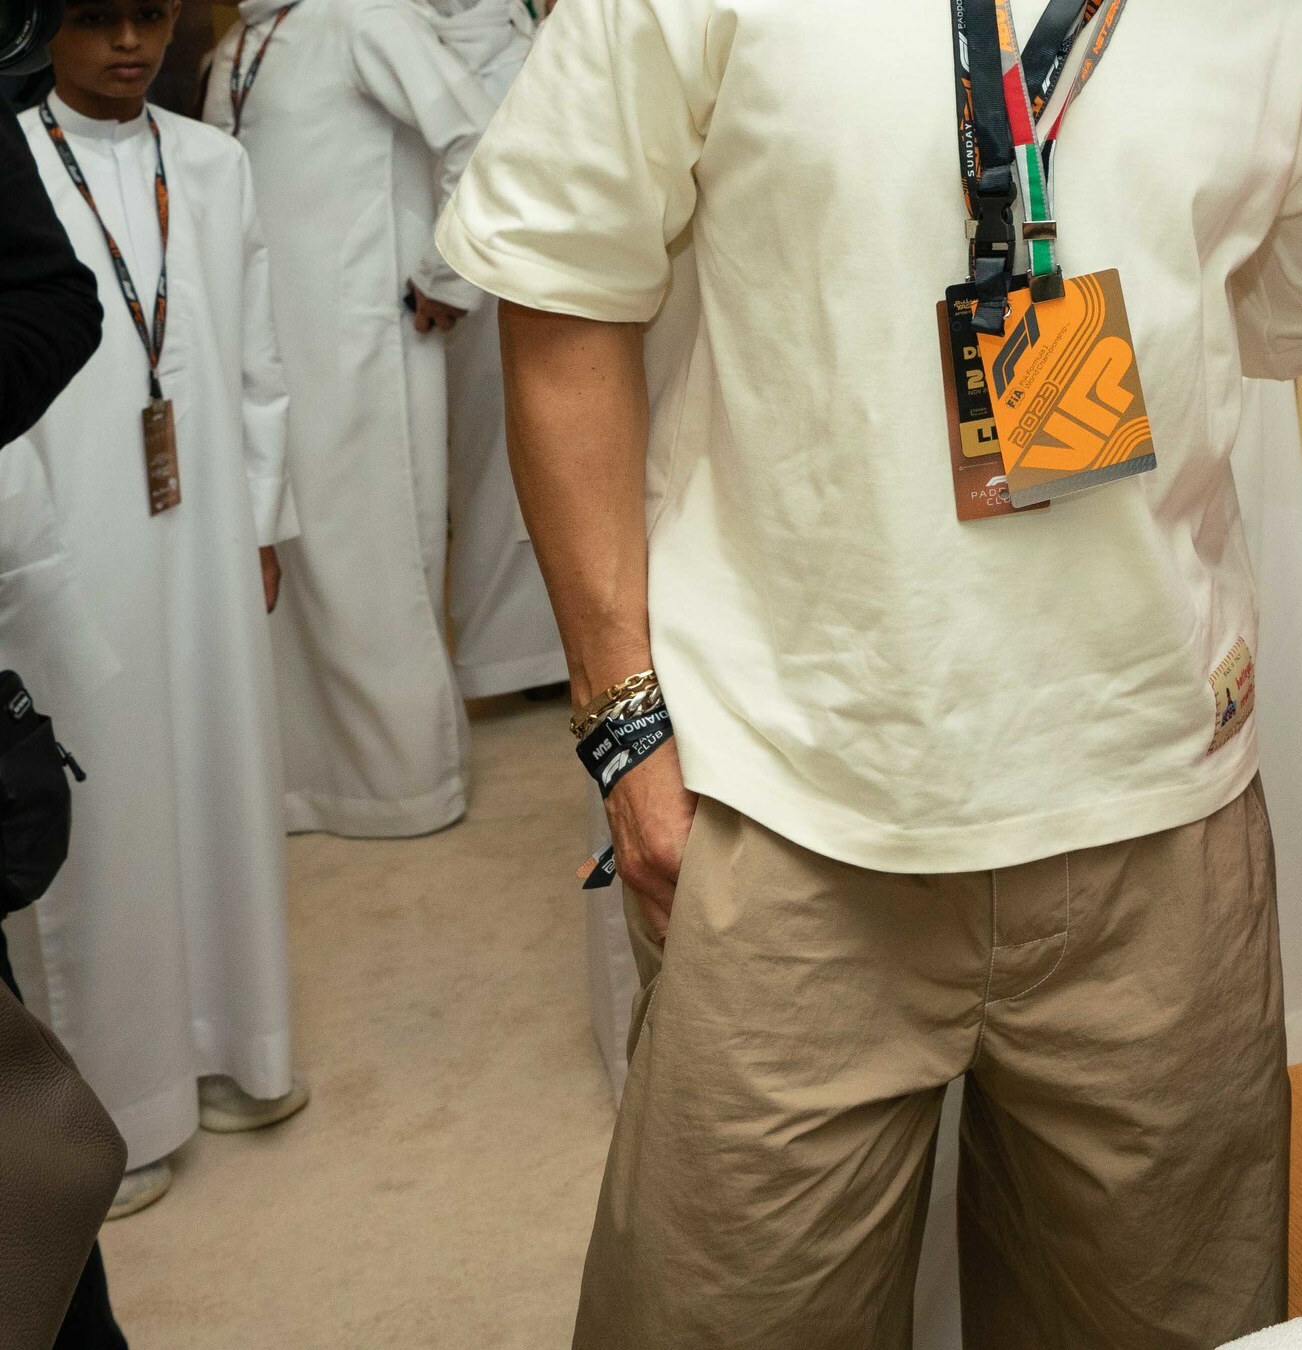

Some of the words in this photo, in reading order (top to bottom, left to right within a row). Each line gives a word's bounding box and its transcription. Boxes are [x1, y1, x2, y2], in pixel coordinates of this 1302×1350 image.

[1093, 30, 1107, 55] NET
[965, 123, 975, 177] SUNDAY
[1023, 368, 1040, 389] World
[1007, 380, 1060, 448] 2023
[1020, 336, 1134, 470] VIP
[614, 710, 669, 738] DIAMON
[592, 738, 613, 760] SUN
[637, 731, 663, 755] CLUB
